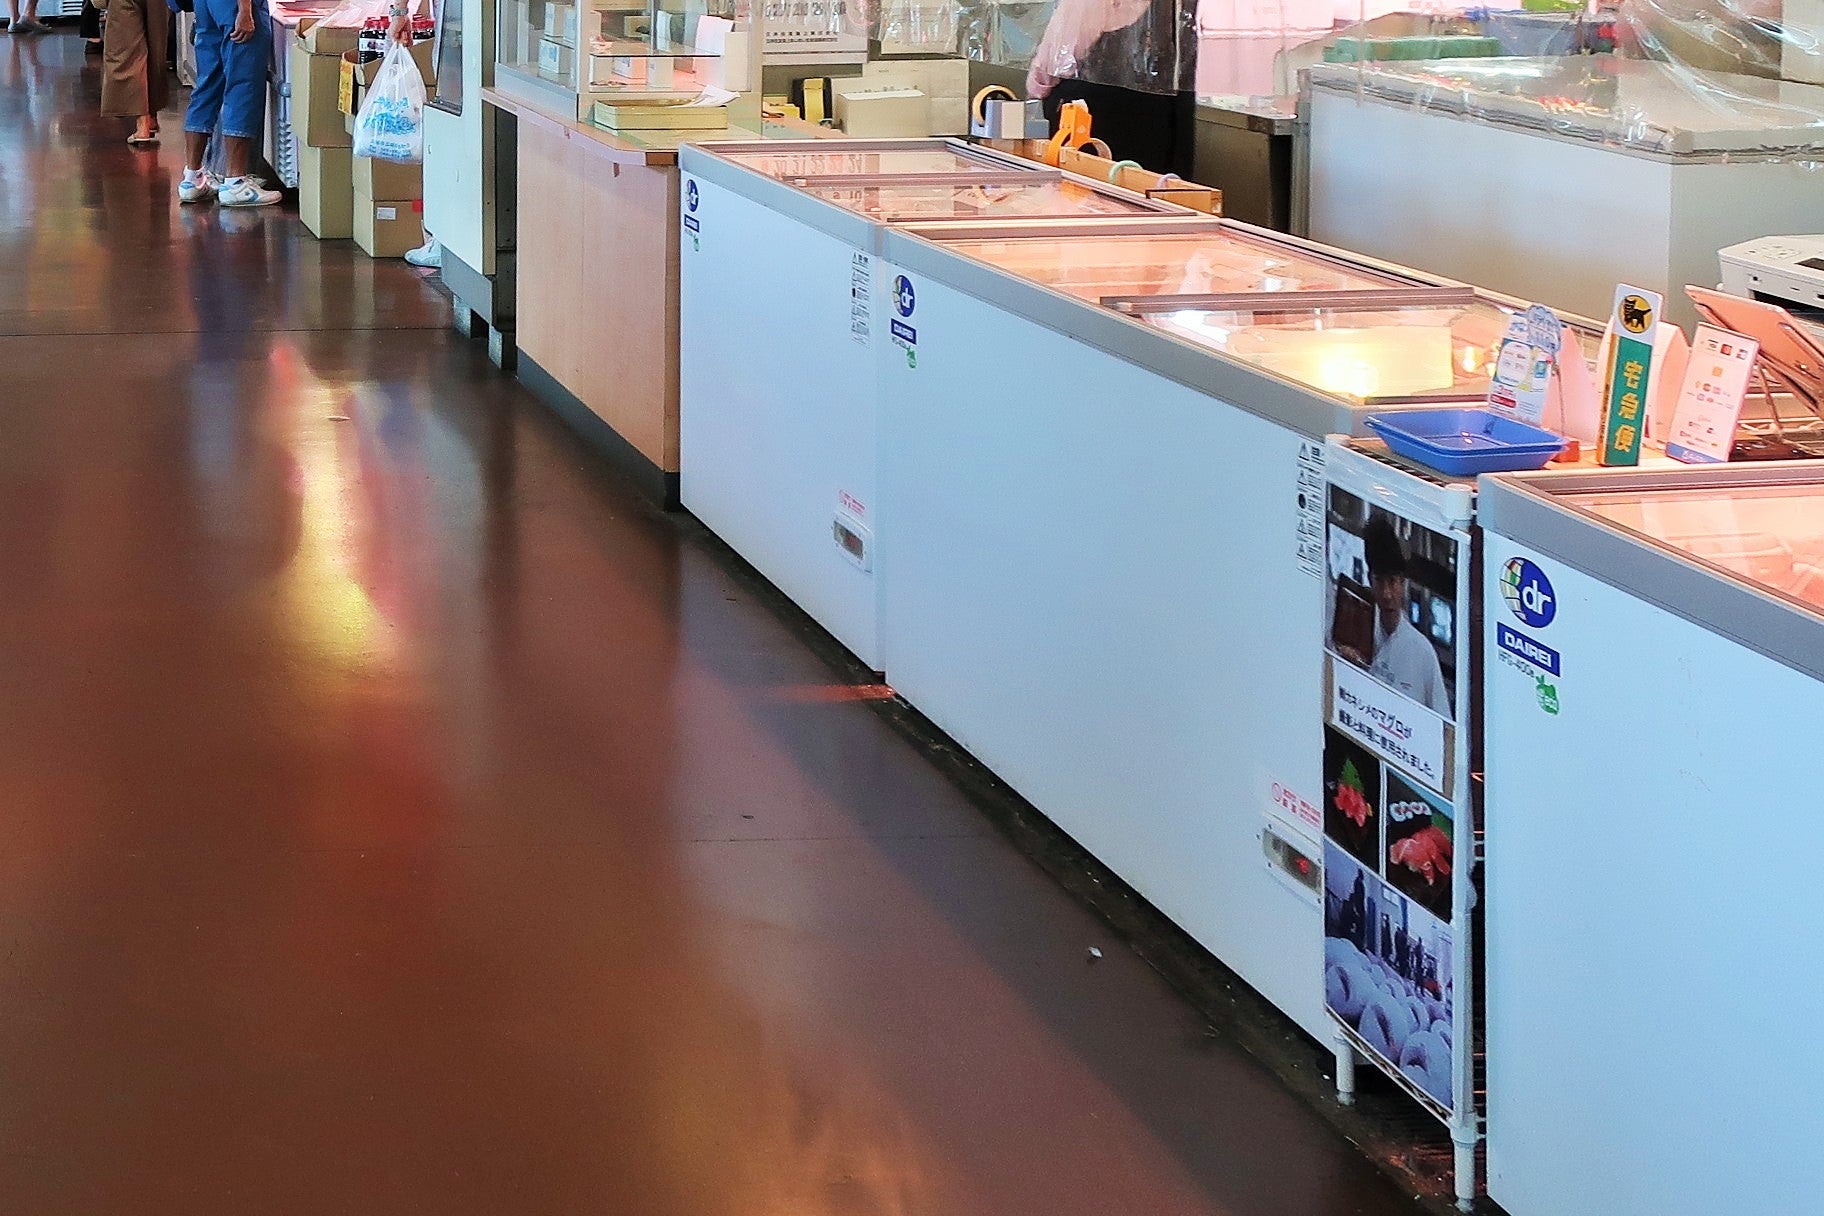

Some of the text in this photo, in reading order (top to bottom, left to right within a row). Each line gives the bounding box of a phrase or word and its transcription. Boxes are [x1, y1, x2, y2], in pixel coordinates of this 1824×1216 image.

[1614, 360, 1645, 453] 宅急便
[1522, 579, 1553, 615] dr
[1504, 631, 1552, 668] DAIREI
